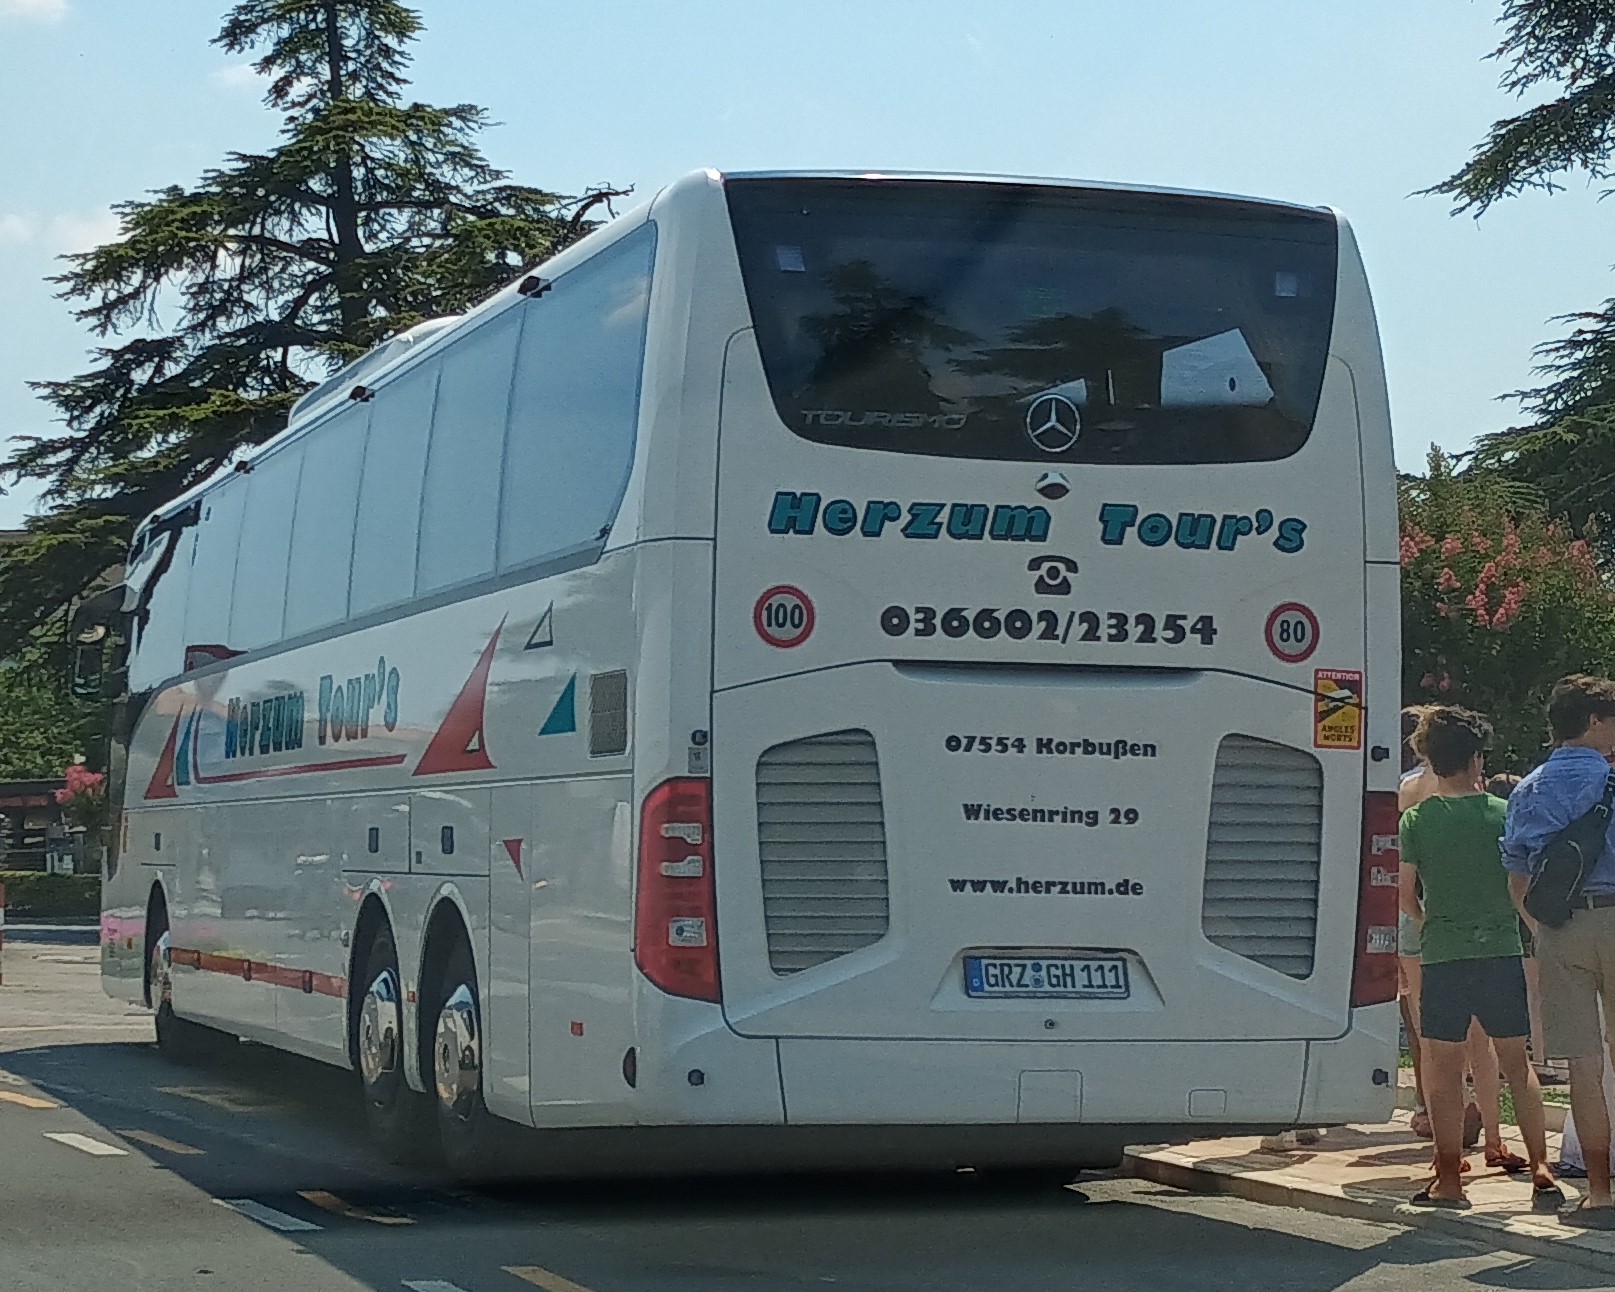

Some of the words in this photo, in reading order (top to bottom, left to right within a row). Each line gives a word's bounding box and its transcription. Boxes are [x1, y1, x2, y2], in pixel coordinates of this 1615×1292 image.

[802, 410, 967, 429] TOURISMO
[768, 491, 1051, 542] Herzum
[1099, 503, 1307, 553] Tour's
[765, 601, 803, 629] 100
[881, 606, 1217, 645] 036602/23254
[1278, 618, 1306, 644] 80
[1317, 671, 1360, 681] ATTENTION
[945, 735, 1026, 754] 07554
[1036, 738, 1157, 759] Korbußen
[962, 803, 1099, 827] Wiesenring
[1109, 807, 1139, 825] 29
[949, 877, 1143, 896] www.herzum.de
[984, 962, 1029, 988] GRZ
[1046, 963, 1076, 988] GH
[1080, 964, 1122, 989] 111
